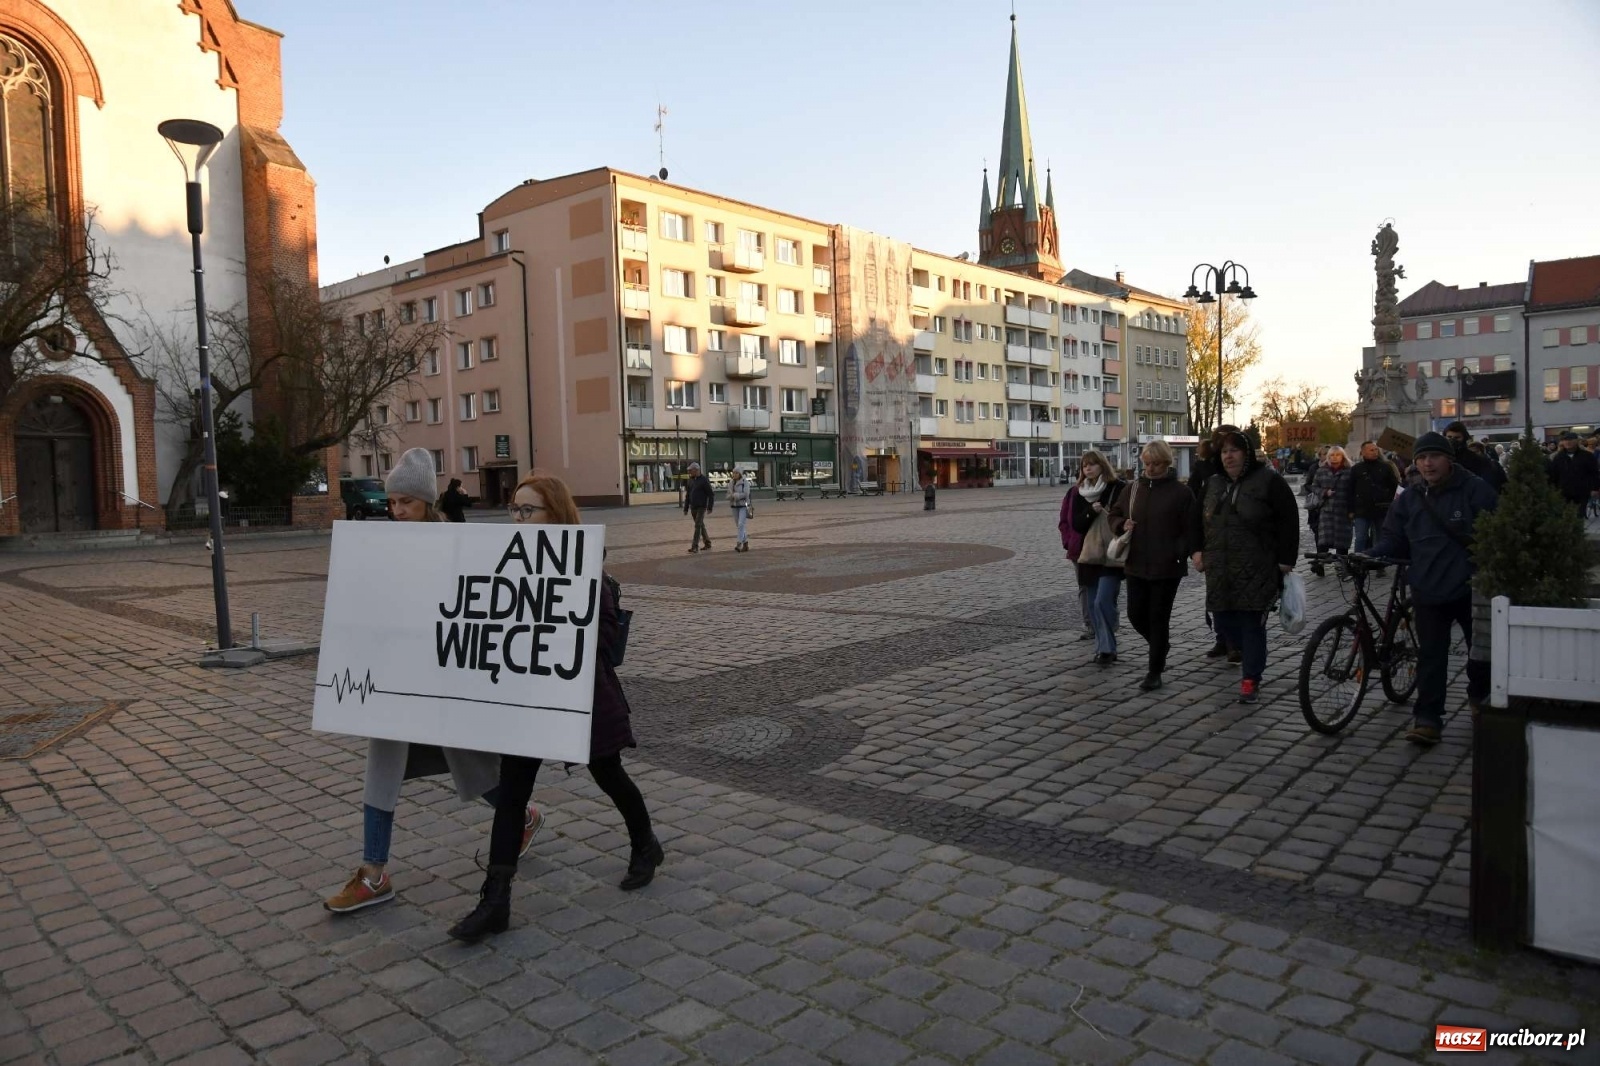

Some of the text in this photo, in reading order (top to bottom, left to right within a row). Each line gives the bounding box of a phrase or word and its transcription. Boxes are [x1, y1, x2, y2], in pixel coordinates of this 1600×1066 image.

[753, 442, 797, 451] JUBILER
[1287, 427, 1316, 437] STOP
[630, 440, 684, 456] STELLA
[495, 530, 584, 576] ANI
[439, 575, 597, 626] JEDNEJ
[436, 621, 584, 684] WIĘCEJ
